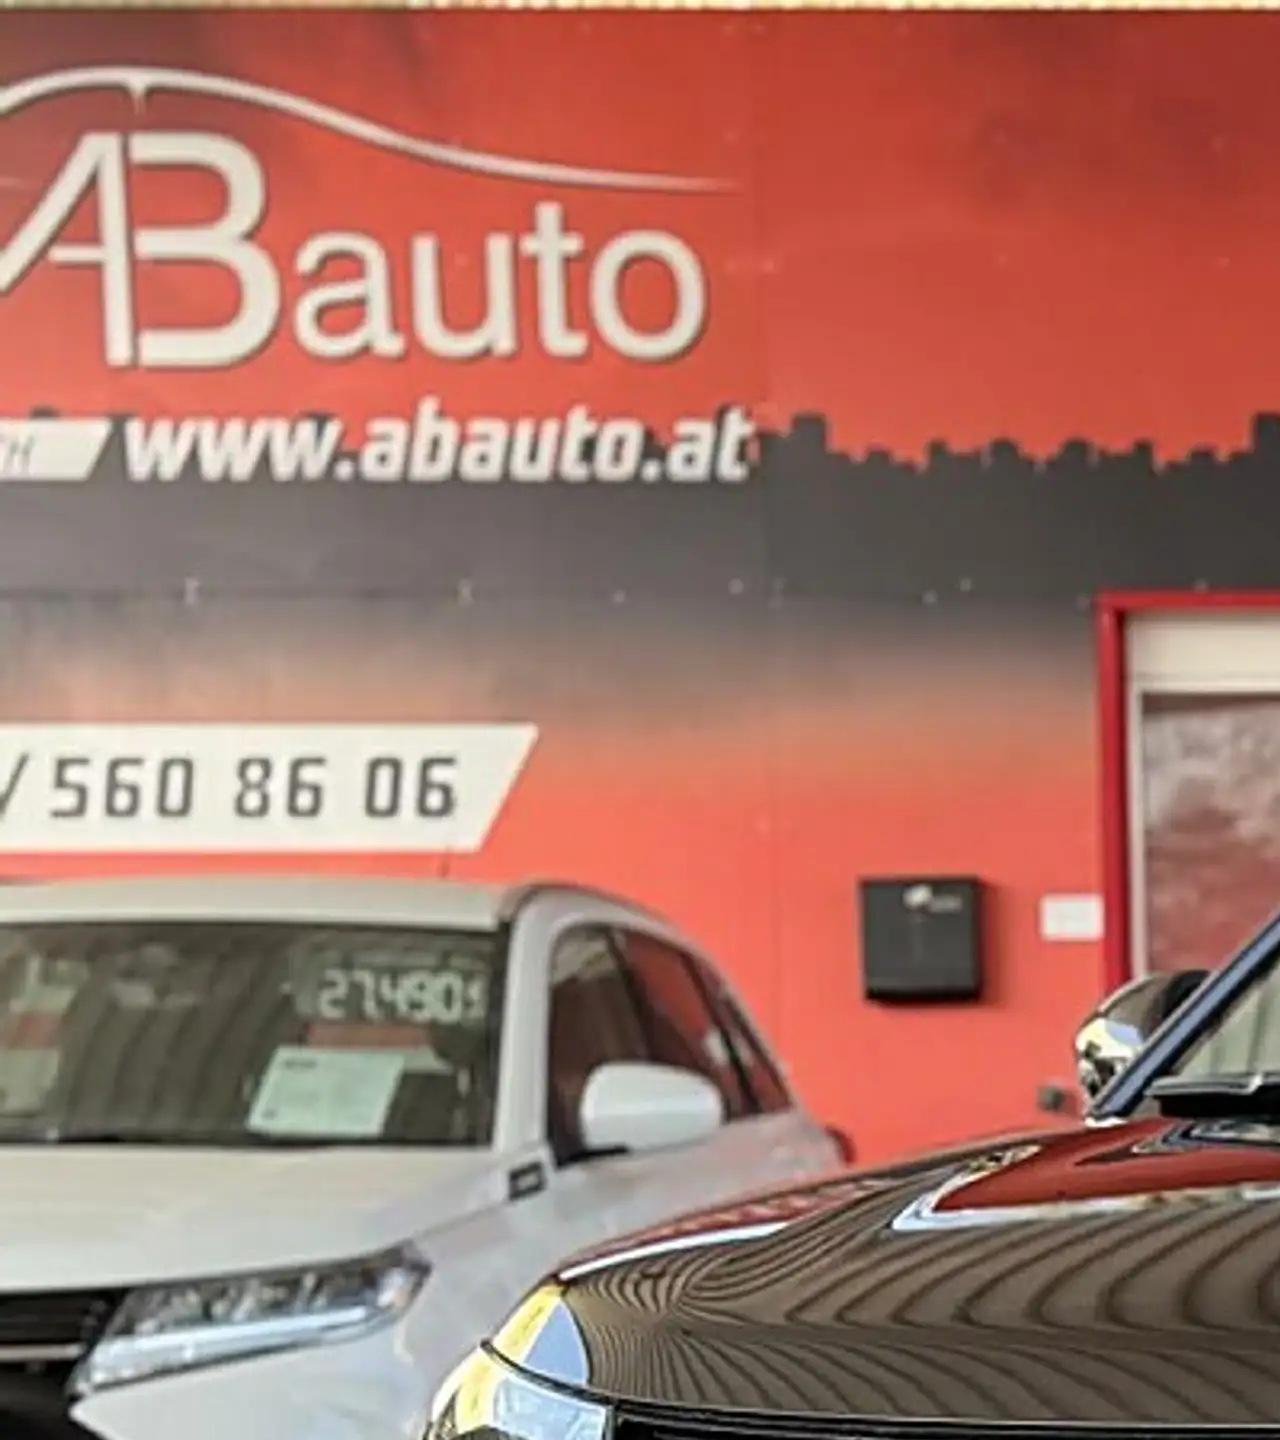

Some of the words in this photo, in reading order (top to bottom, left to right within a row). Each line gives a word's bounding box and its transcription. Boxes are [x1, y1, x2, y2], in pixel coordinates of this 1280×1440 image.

[0, 131, 708, 369] ABauto
[122, 397, 754, 483] www.abauto.at
[234, 755, 327, 819] 86
[363, 755, 459, 819] 06
